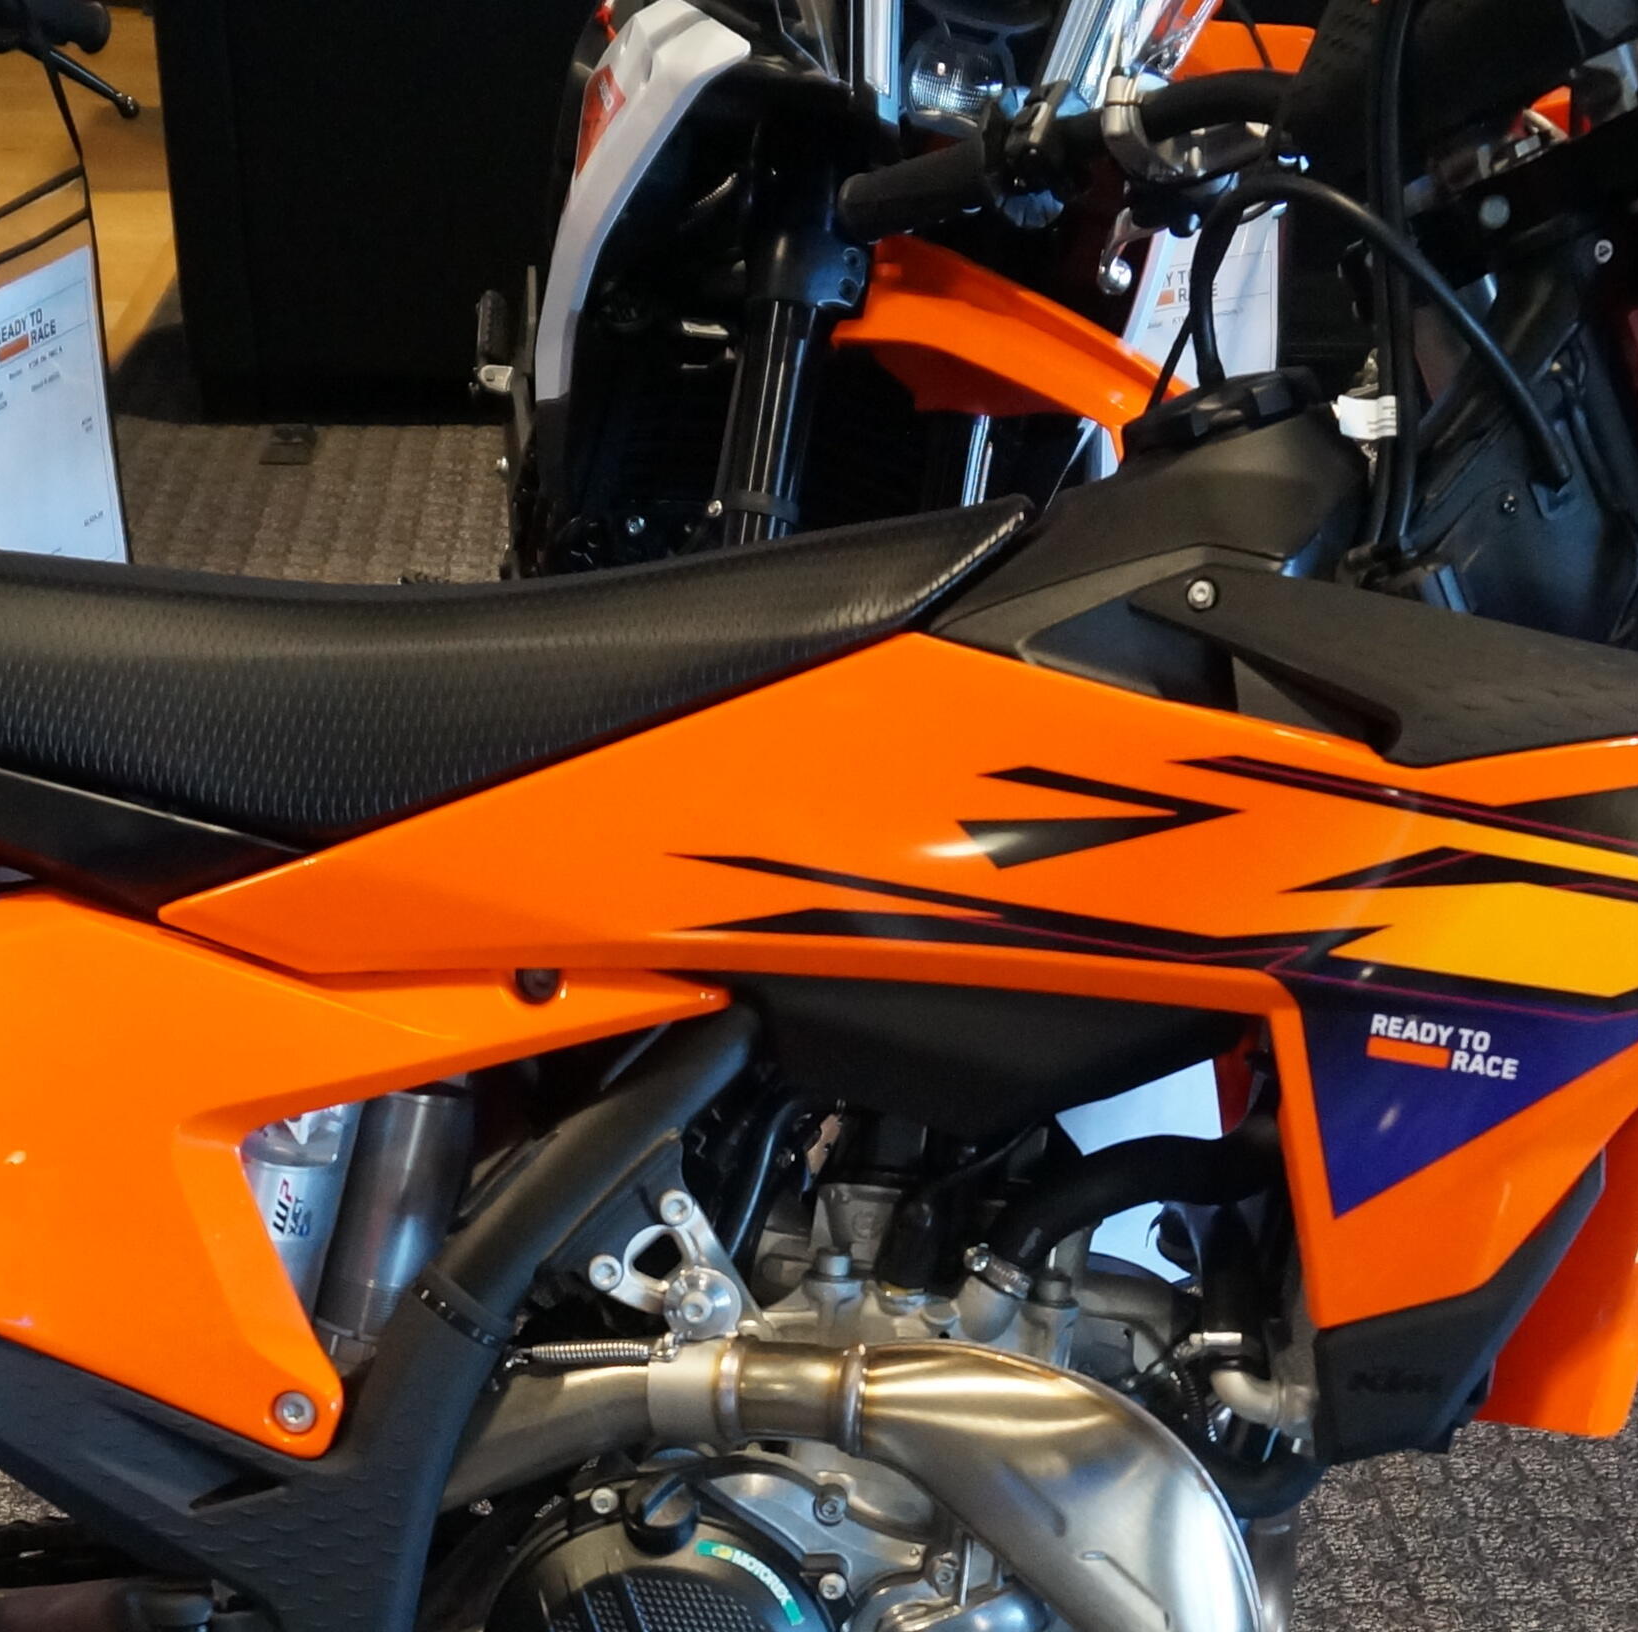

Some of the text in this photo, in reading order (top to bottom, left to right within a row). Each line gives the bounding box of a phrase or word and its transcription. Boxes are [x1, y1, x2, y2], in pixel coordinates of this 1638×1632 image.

[29, 307, 44, 327] TO
[30, 319, 57, 345] RACE
[1370, 1013, 1492, 1053] READY TO
[1451, 1050, 1520, 1080] RACE
[272, 1177, 293, 1235] WP
